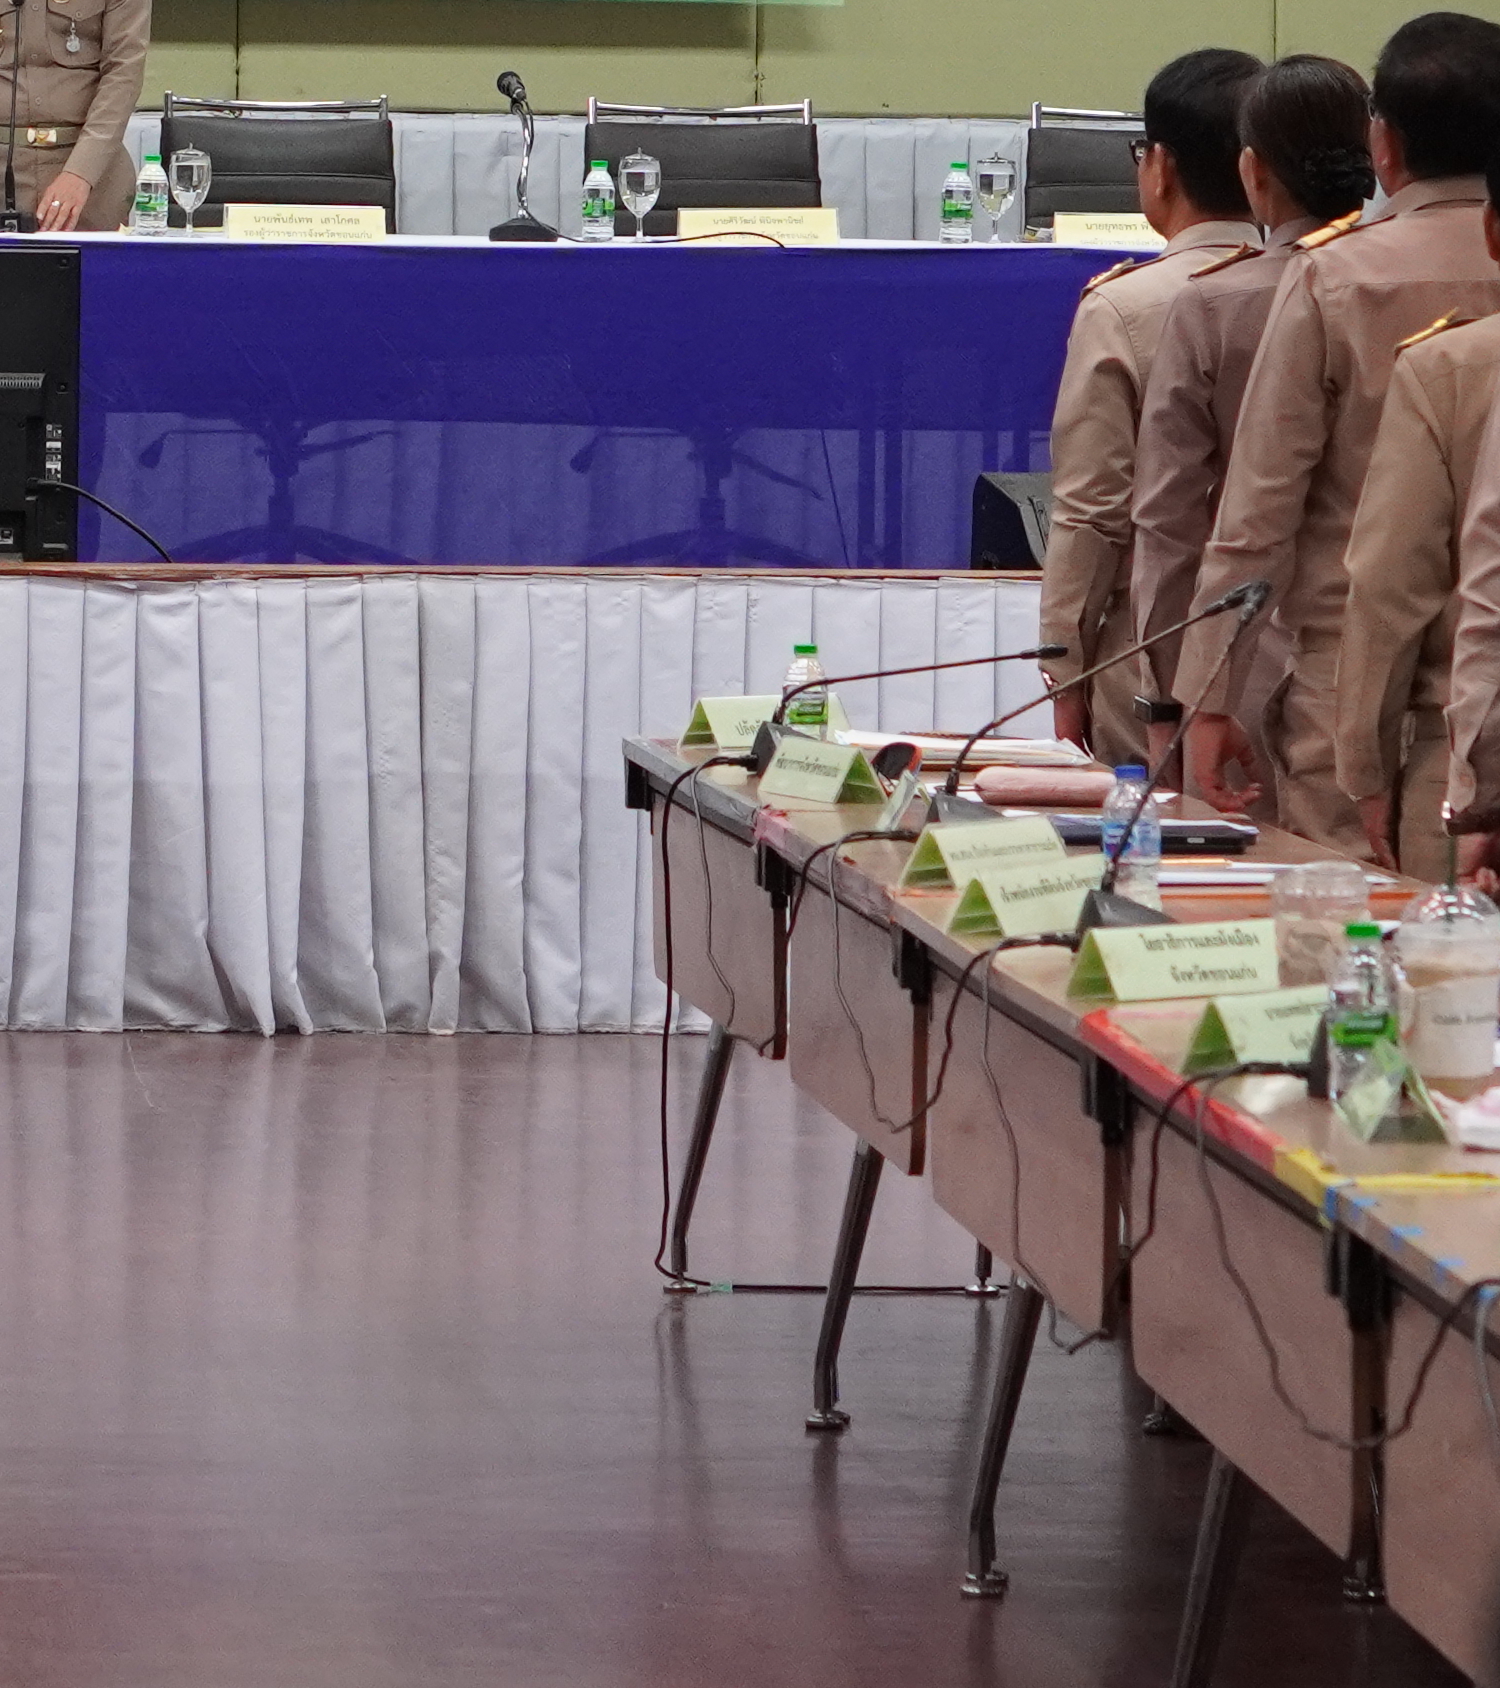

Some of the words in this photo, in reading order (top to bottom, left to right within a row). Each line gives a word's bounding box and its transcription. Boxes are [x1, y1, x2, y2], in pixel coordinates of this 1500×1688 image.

[1170, 962, 1258, 983] จังหวัดขอนแก่น
